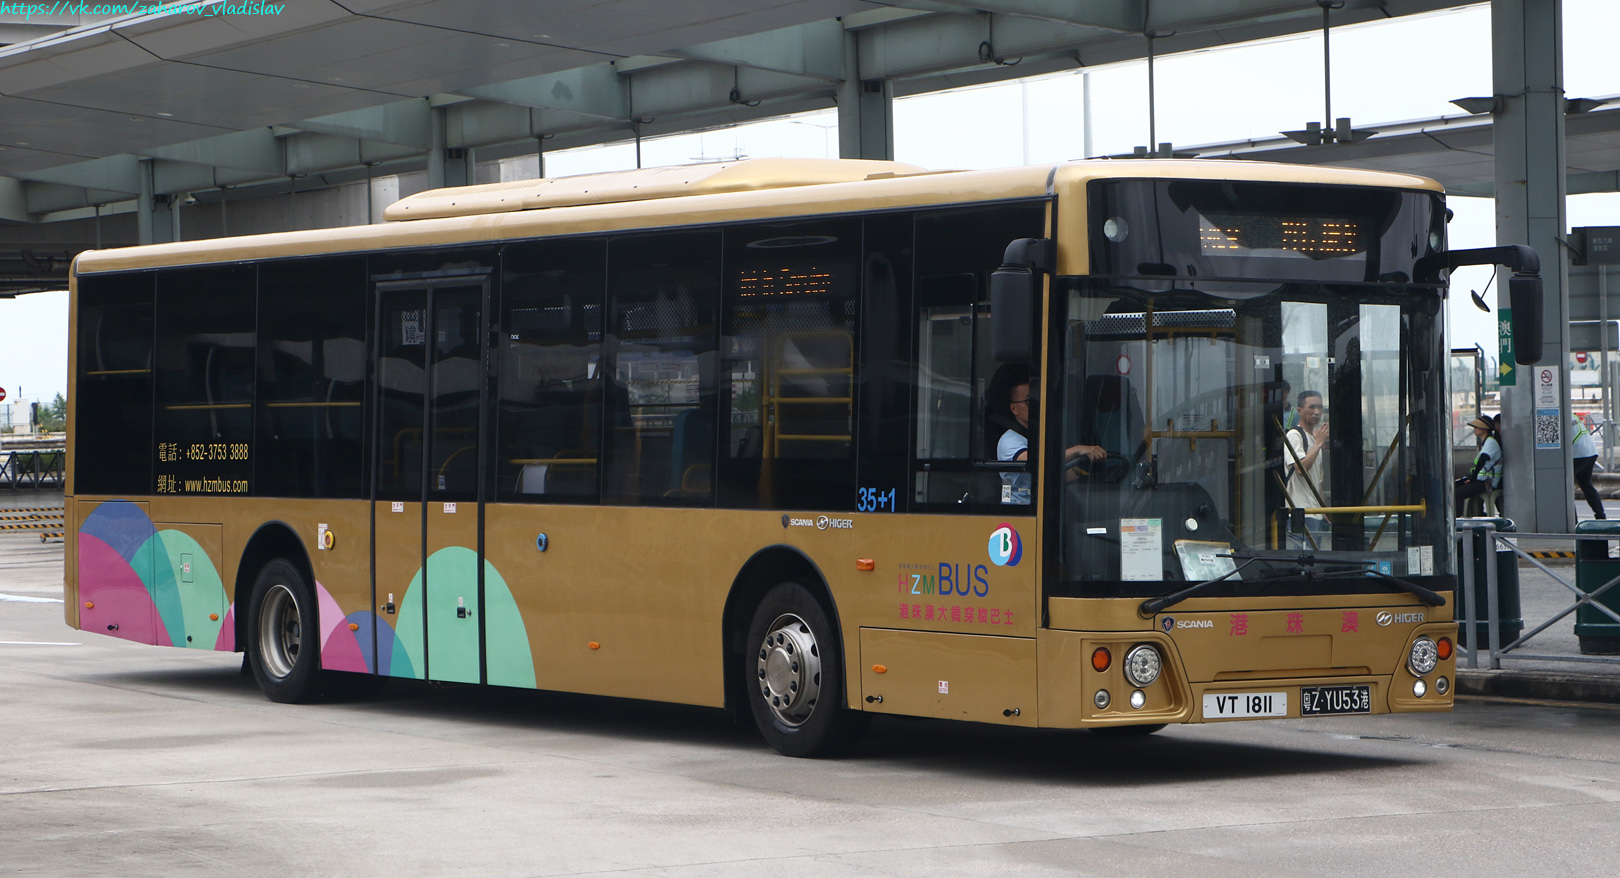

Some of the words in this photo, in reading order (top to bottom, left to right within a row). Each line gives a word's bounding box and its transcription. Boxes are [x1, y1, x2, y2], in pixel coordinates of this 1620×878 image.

[186, 443, 227, 460] +852-3753
[229, 443, 249, 460] 3888
[184, 476, 248, 493] www.hzmbus.com
[857, 487, 896, 513] 35+1
[790, 518, 814, 527] SCANIA
[829, 518, 853, 529] HIGER
[899, 602, 1014, 626] 港珠澳大橋穿梭巴士
[1394, 612, 1424, 624] HIGER
[1177, 620, 1214, 629] SCANIA
[1216, 695, 1239, 714] VT
[1246, 695, 1273, 714] 1811
